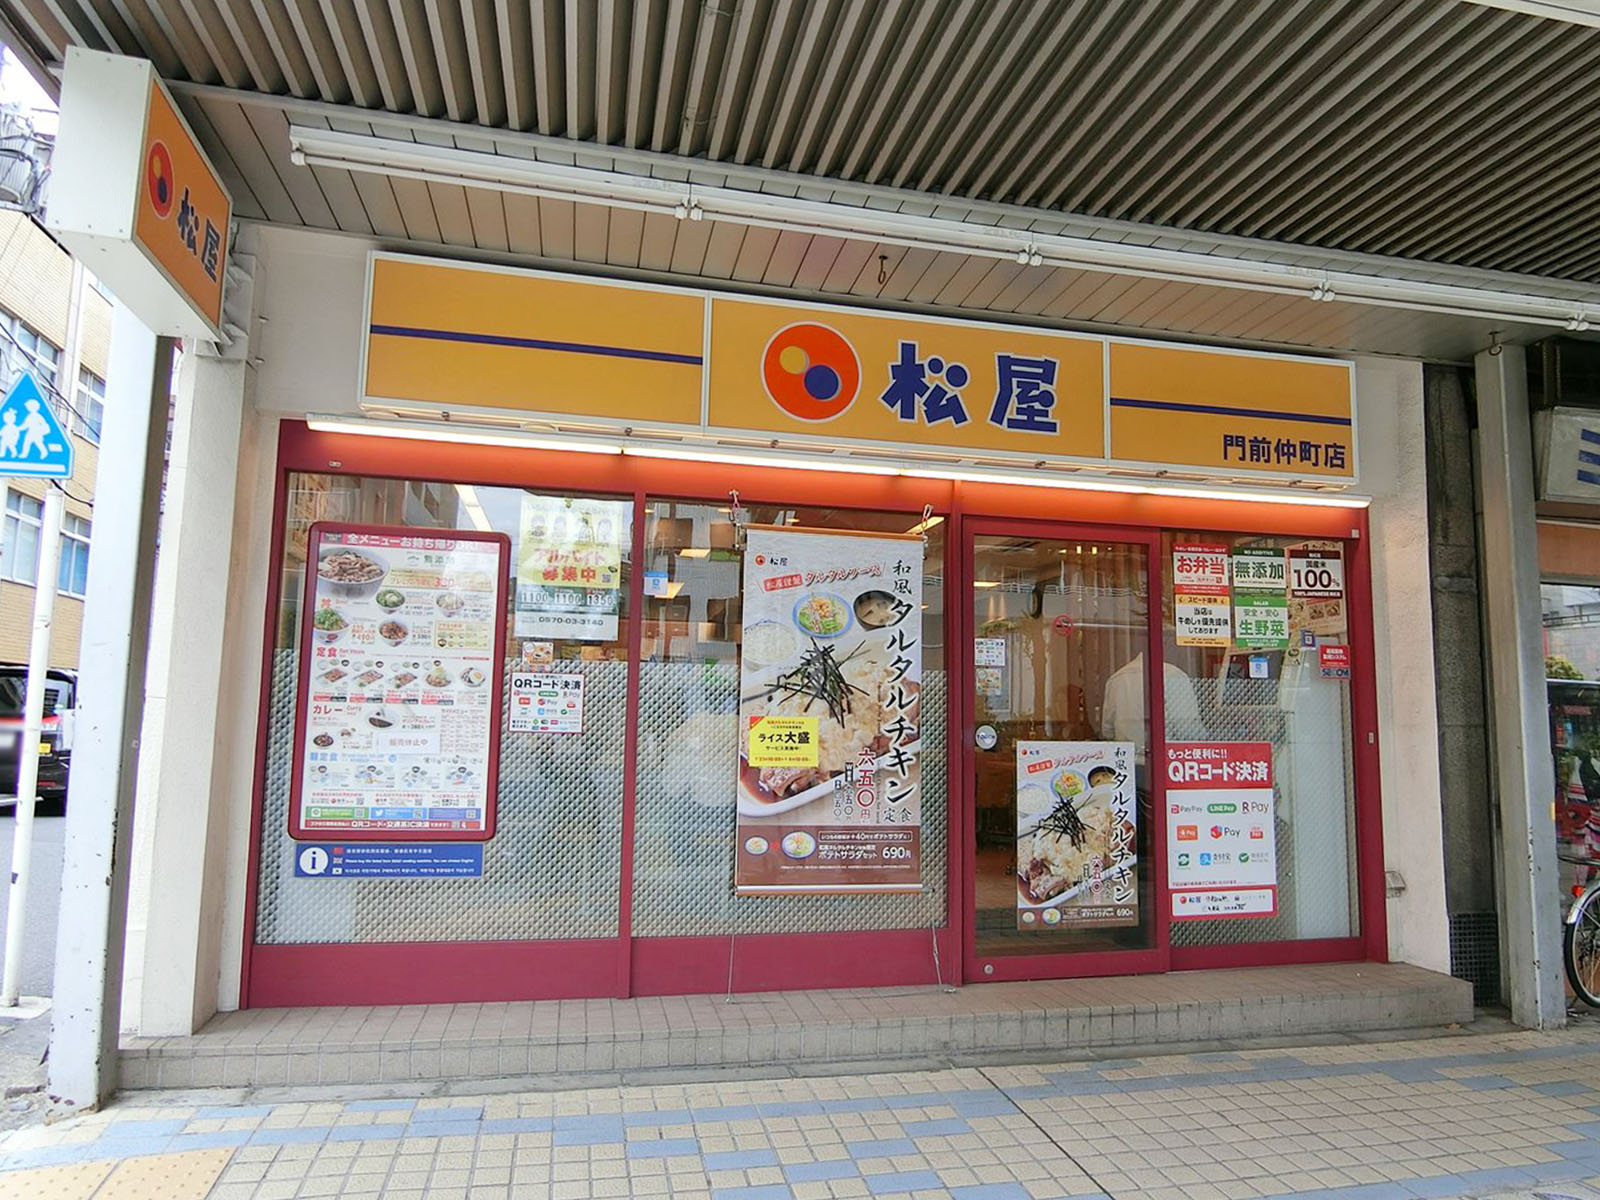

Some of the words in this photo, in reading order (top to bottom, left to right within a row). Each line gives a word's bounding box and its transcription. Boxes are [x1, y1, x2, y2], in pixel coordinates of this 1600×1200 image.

[177, 186, 221, 283] 松屋
[880, 339, 1061, 434] 松屋
[1222, 433, 1346, 470] 門前仲町店
[542, 565, 596, 582] 募集中
[1177, 556, 1225, 576] お弁当
[1235, 560, 1284, 579] 無添加
[1294, 569, 1340, 588] 100%
[1244, 609, 1279, 617] 安全・安心
[1240, 620, 1285, 637] 生野菜
[514, 679, 581, 689] QRコード決済
[313, 705, 342, 715] カレー
[759, 731, 810, 744] ライス大盛
[1167, 748, 1229, 760] もっと便利に!!
[1168, 761, 1269, 783] QRコード決済
[883, 808, 912, 822] 定食
[1251, 802, 1269, 813] Pay
[1224, 828, 1241, 838] Pay
